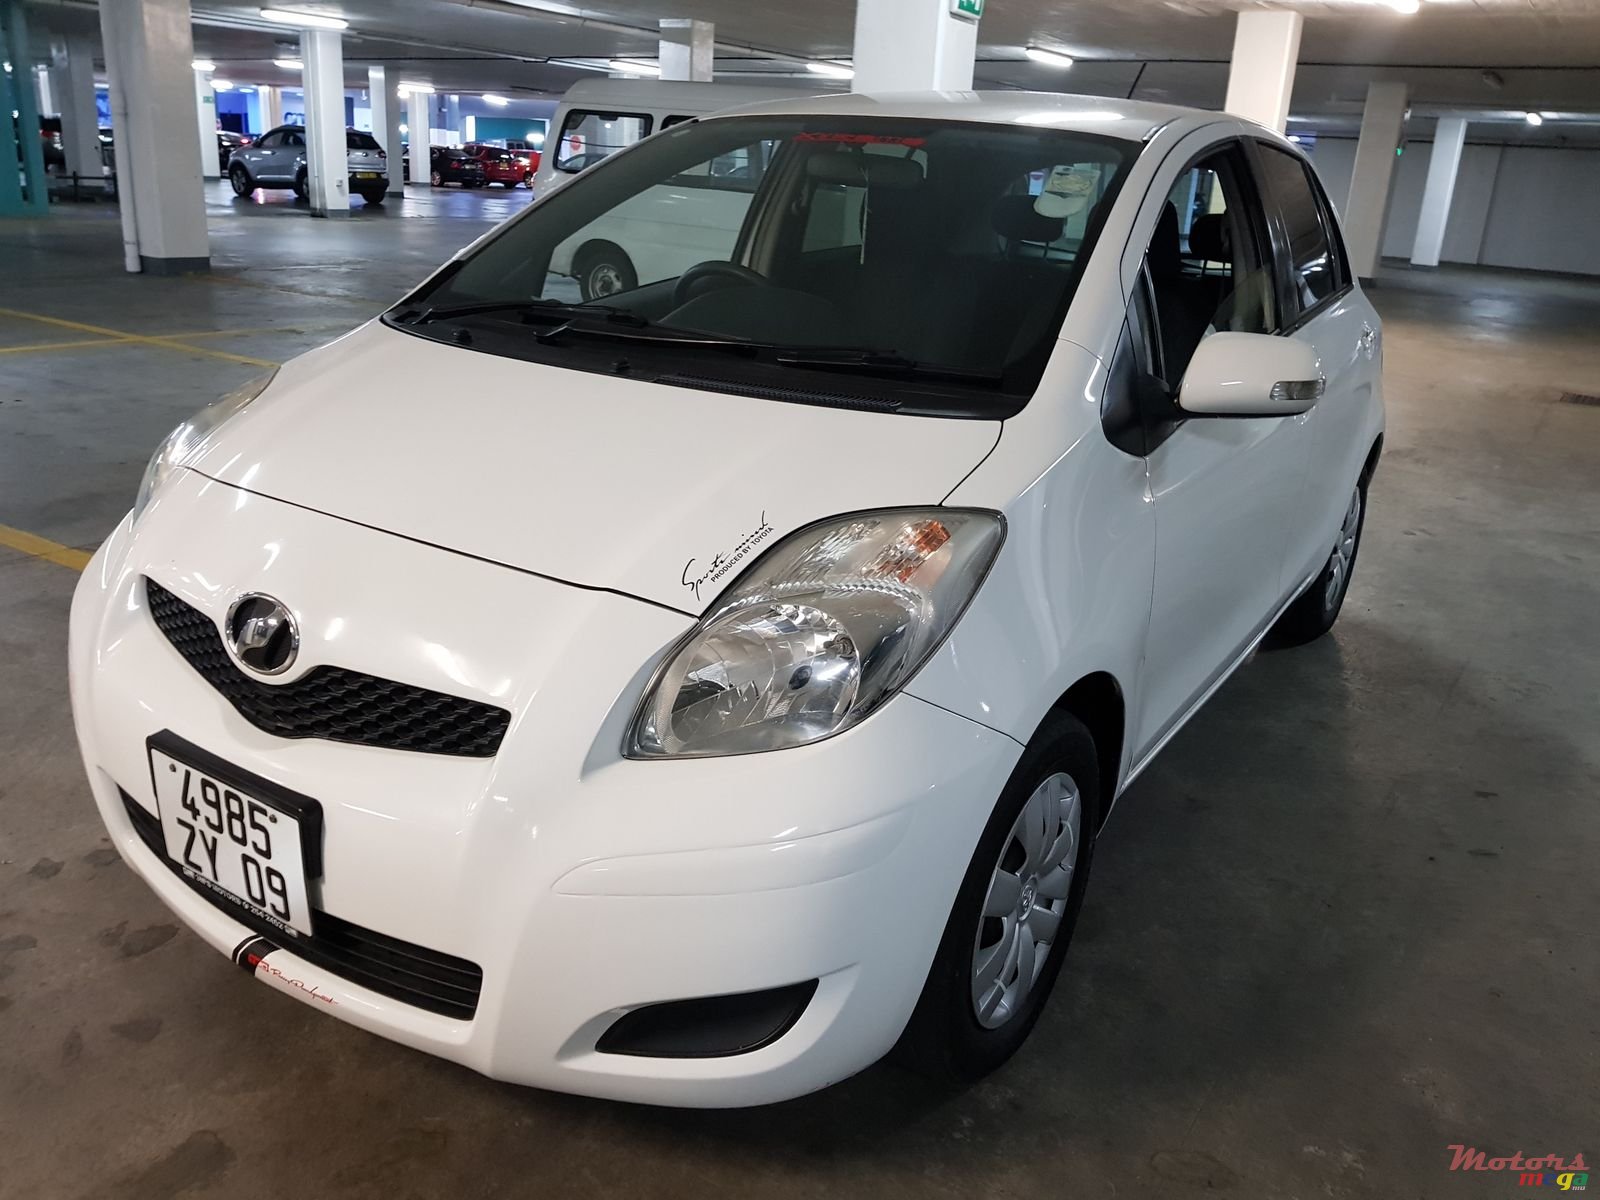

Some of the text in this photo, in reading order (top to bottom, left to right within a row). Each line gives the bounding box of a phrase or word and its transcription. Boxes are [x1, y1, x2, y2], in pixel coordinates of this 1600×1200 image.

[710, 526, 774, 583] PRODUCED BY TOYOTA
[181, 769, 272, 860] 4985
[176, 817, 219, 882] ZY
[241, 853, 291, 922] 09
